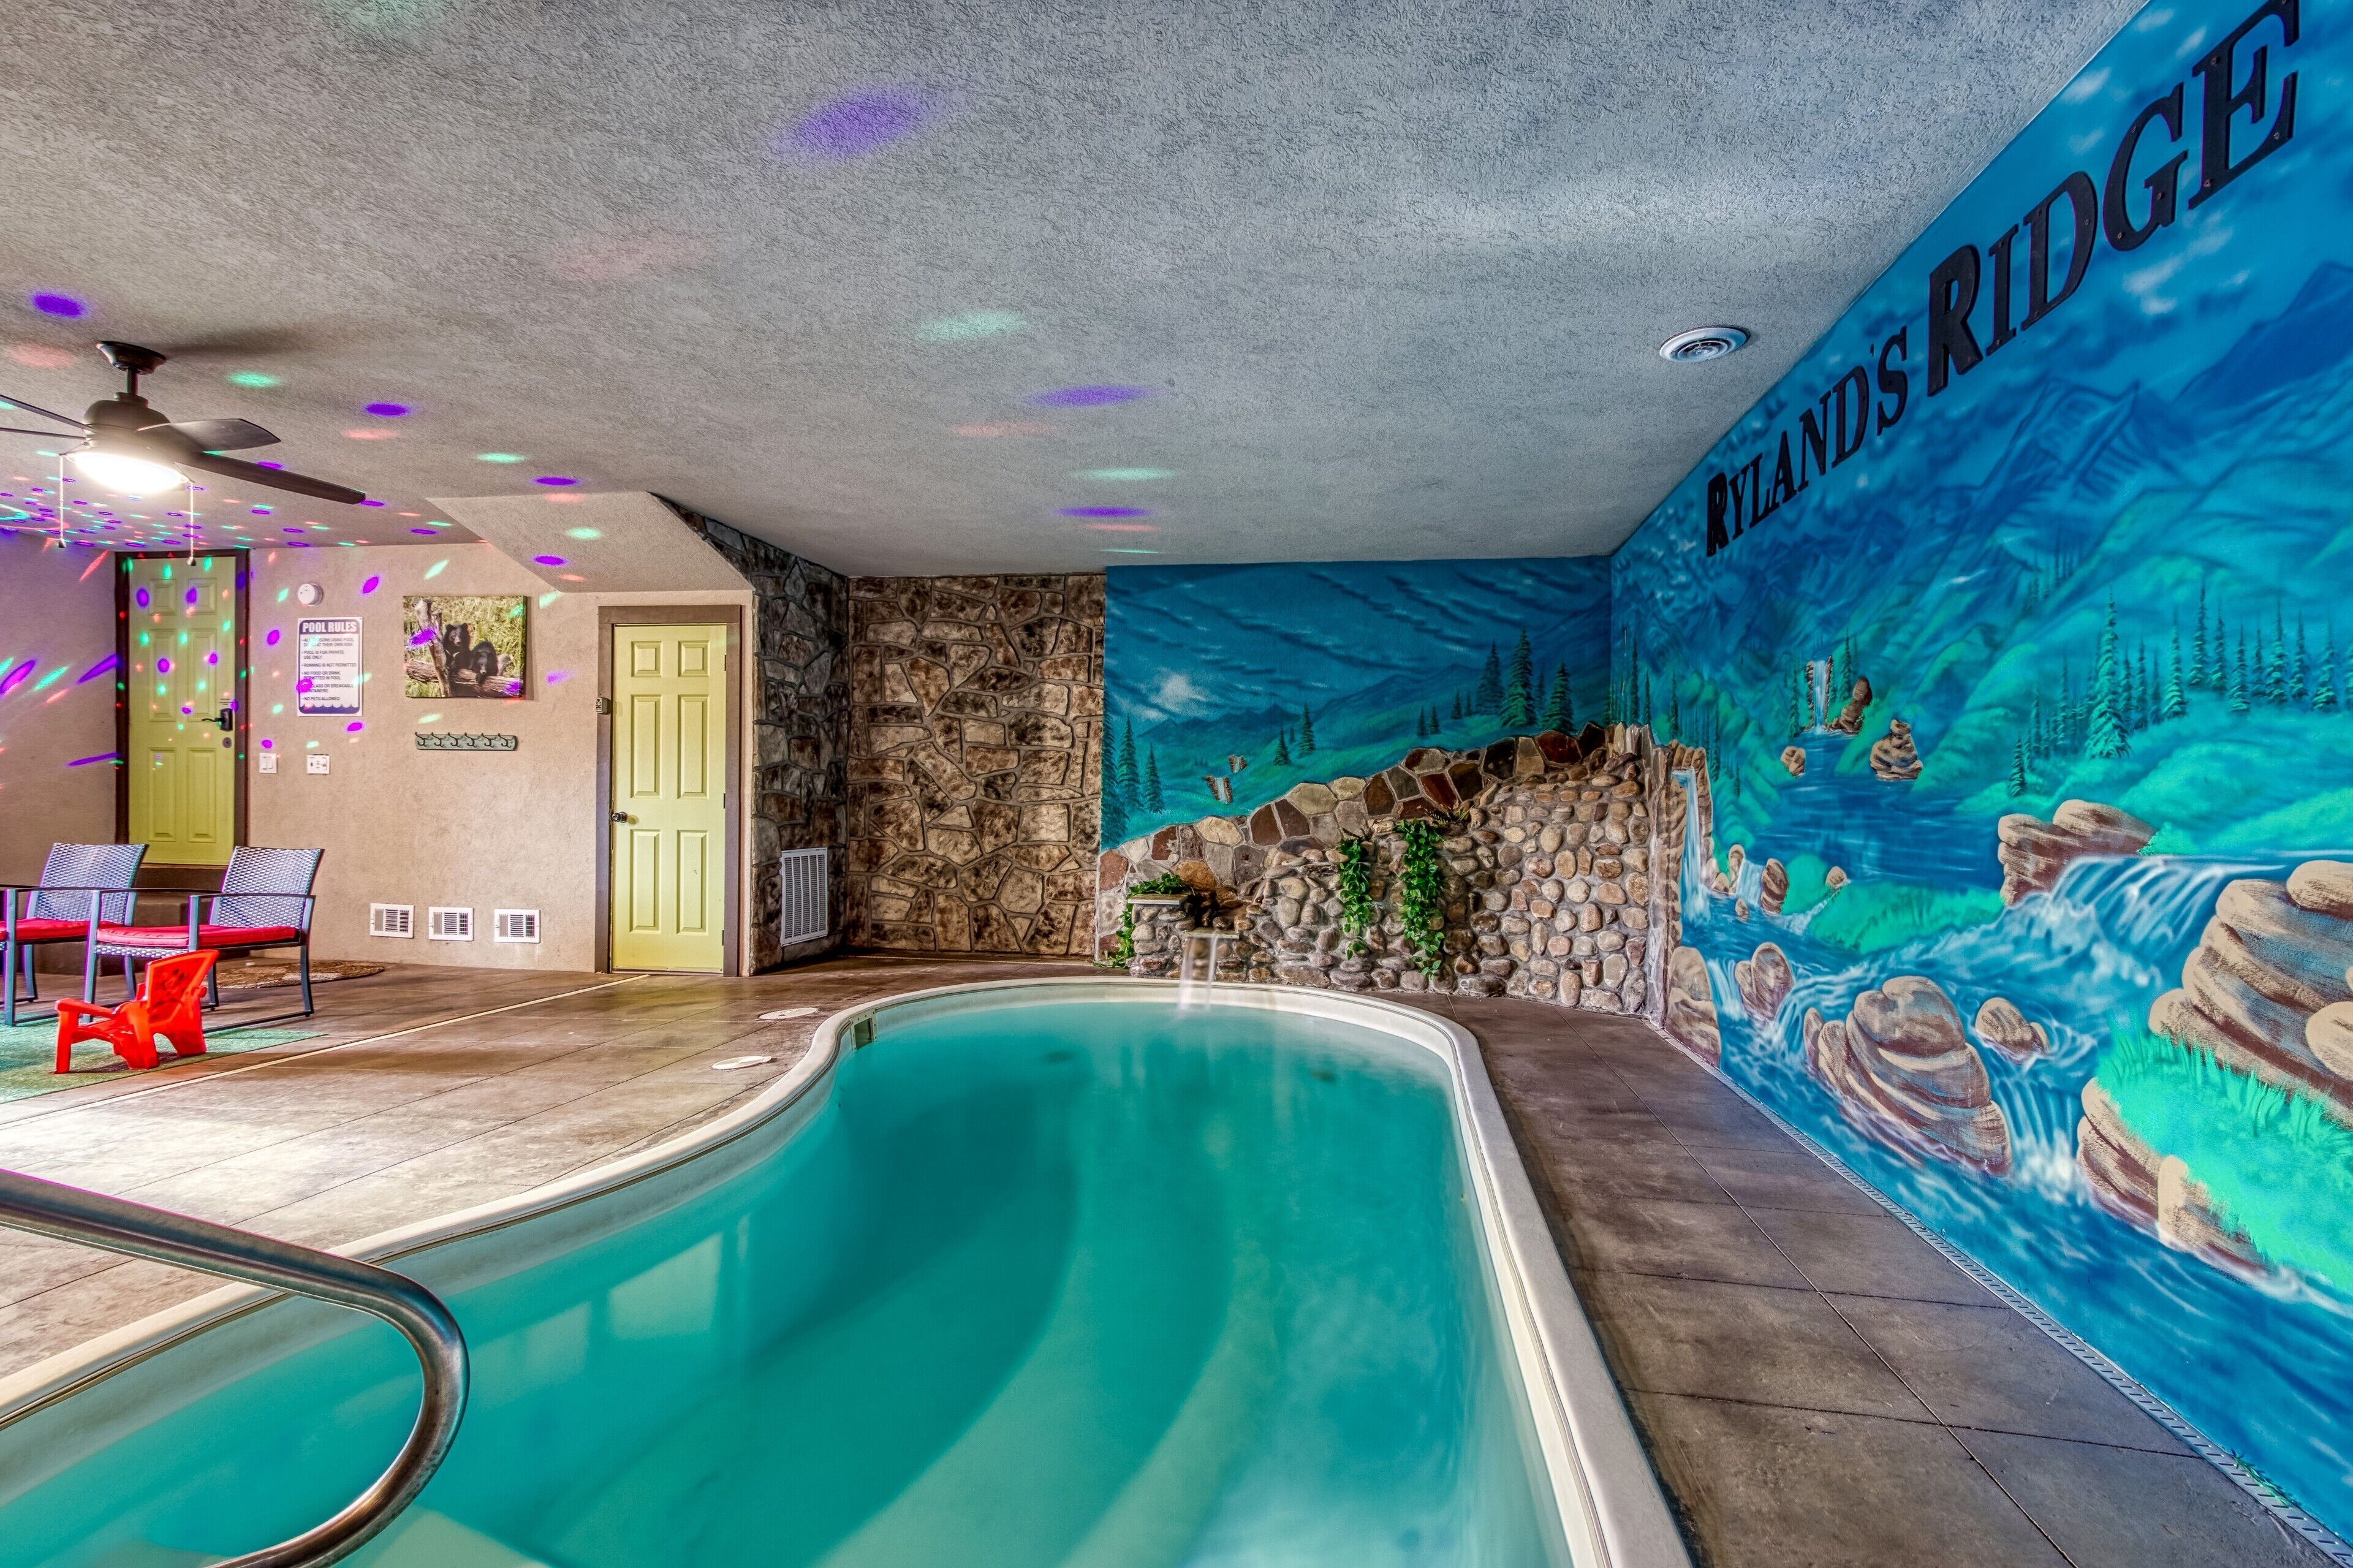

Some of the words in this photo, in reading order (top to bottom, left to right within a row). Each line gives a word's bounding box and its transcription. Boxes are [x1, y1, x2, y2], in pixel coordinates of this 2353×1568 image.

[1707, 326, 1908, 557] RYLAND'S
[1927, 0, 2299, 396] RIDGE
[302, 622, 327, 632] POOL
[328, 621, 357, 632] RULES
